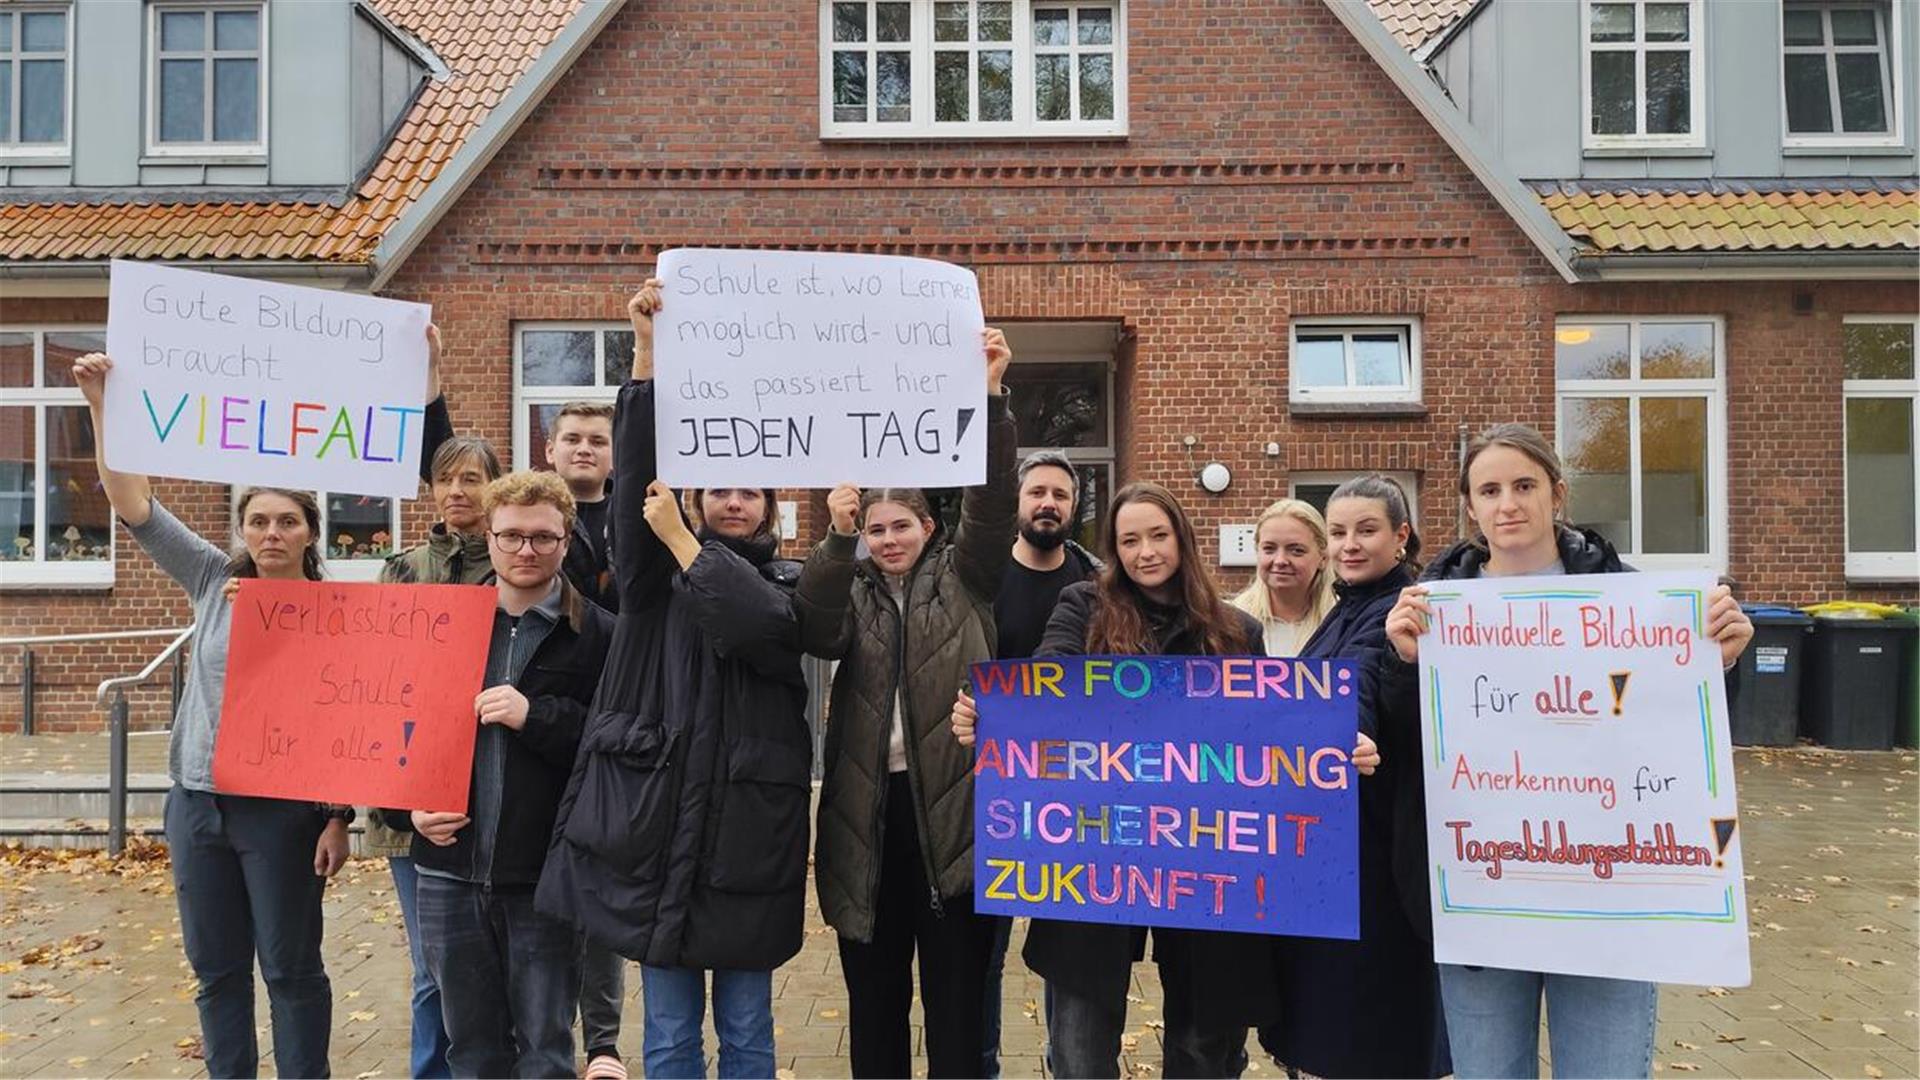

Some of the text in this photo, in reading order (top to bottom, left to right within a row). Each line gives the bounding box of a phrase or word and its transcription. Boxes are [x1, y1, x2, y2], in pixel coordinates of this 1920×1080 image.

[677, 263, 782, 297] Schule
[841, 275, 883, 297] wo
[143, 284, 385, 364] Gute Bildung
[895, 307, 953, 347] und
[142, 336, 283, 382] braucht
[679, 362, 949, 413] das passiert hier
[142, 388, 425, 464] VIELFALT
[677, 414, 814, 458] JEDEN
[1437, 601, 1692, 666] Individuelle Bildung
[312, 657, 416, 709] Schule
[971, 661, 1066, 699] WIR
[1470, 674, 1520, 718] für
[972, 737, 1350, 791] ANERKENNUNG
[1450, 749, 1679, 811] Anerkennung für
[985, 798, 1322, 858] SICHERHEIT
